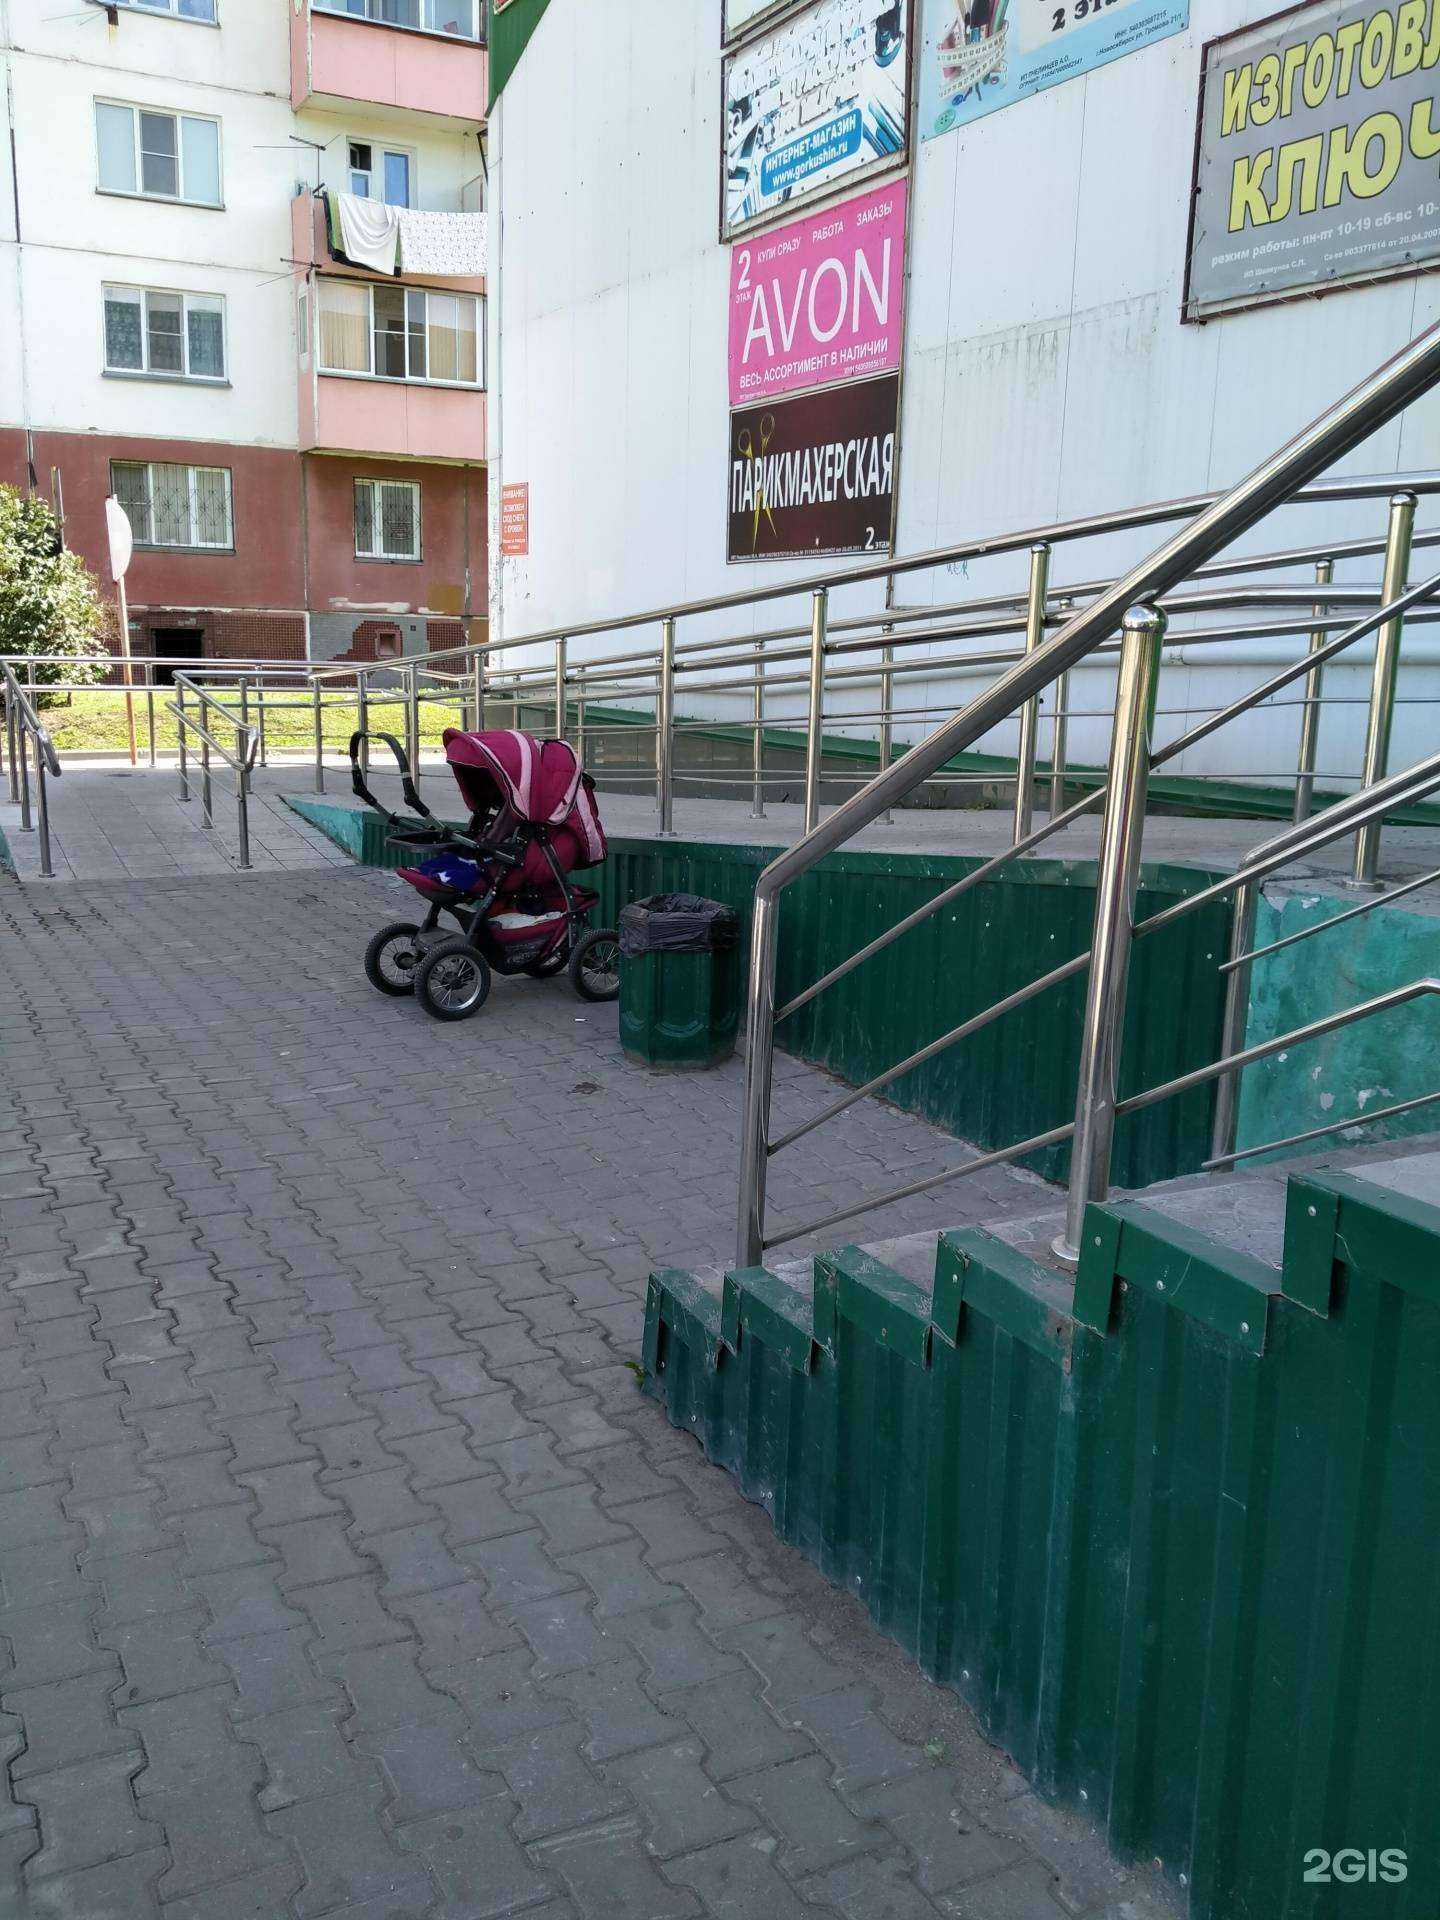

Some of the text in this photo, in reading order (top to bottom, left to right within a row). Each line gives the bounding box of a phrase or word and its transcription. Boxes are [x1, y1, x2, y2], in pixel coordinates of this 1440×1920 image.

[1052, 8, 1065, 31] 2
[765, 114, 856, 174] ИНТЕРНЕТ-МАГАЗИН
[772, 142, 848, 187] www.gorkushin.ru
[757, 200, 893, 264] КУПИ СРАЗУ РАБОТА ЗАКАЗЫ
[1211, 250, 1249, 268] режим
[1253, 238, 1299, 259] работы:
[1302, 229, 1333, 246] пн-пт
[1337, 217, 1371, 236] 10-19
[1375, 210, 1412, 228] сб-вс
[738, 250, 751, 291] 2
[742, 238, 891, 364] AVON
[740, 371, 762, 388] ВЕСЬ
[763, 354, 830, 383] АССОРТИМЕНТ
[830, 351, 838, 366] В
[840, 337, 888, 363] НАЛИЧИИ
[732, 433, 895, 513] ПАРИКМАХЕРСКАЯ
[864, 526, 875, 550] 2
